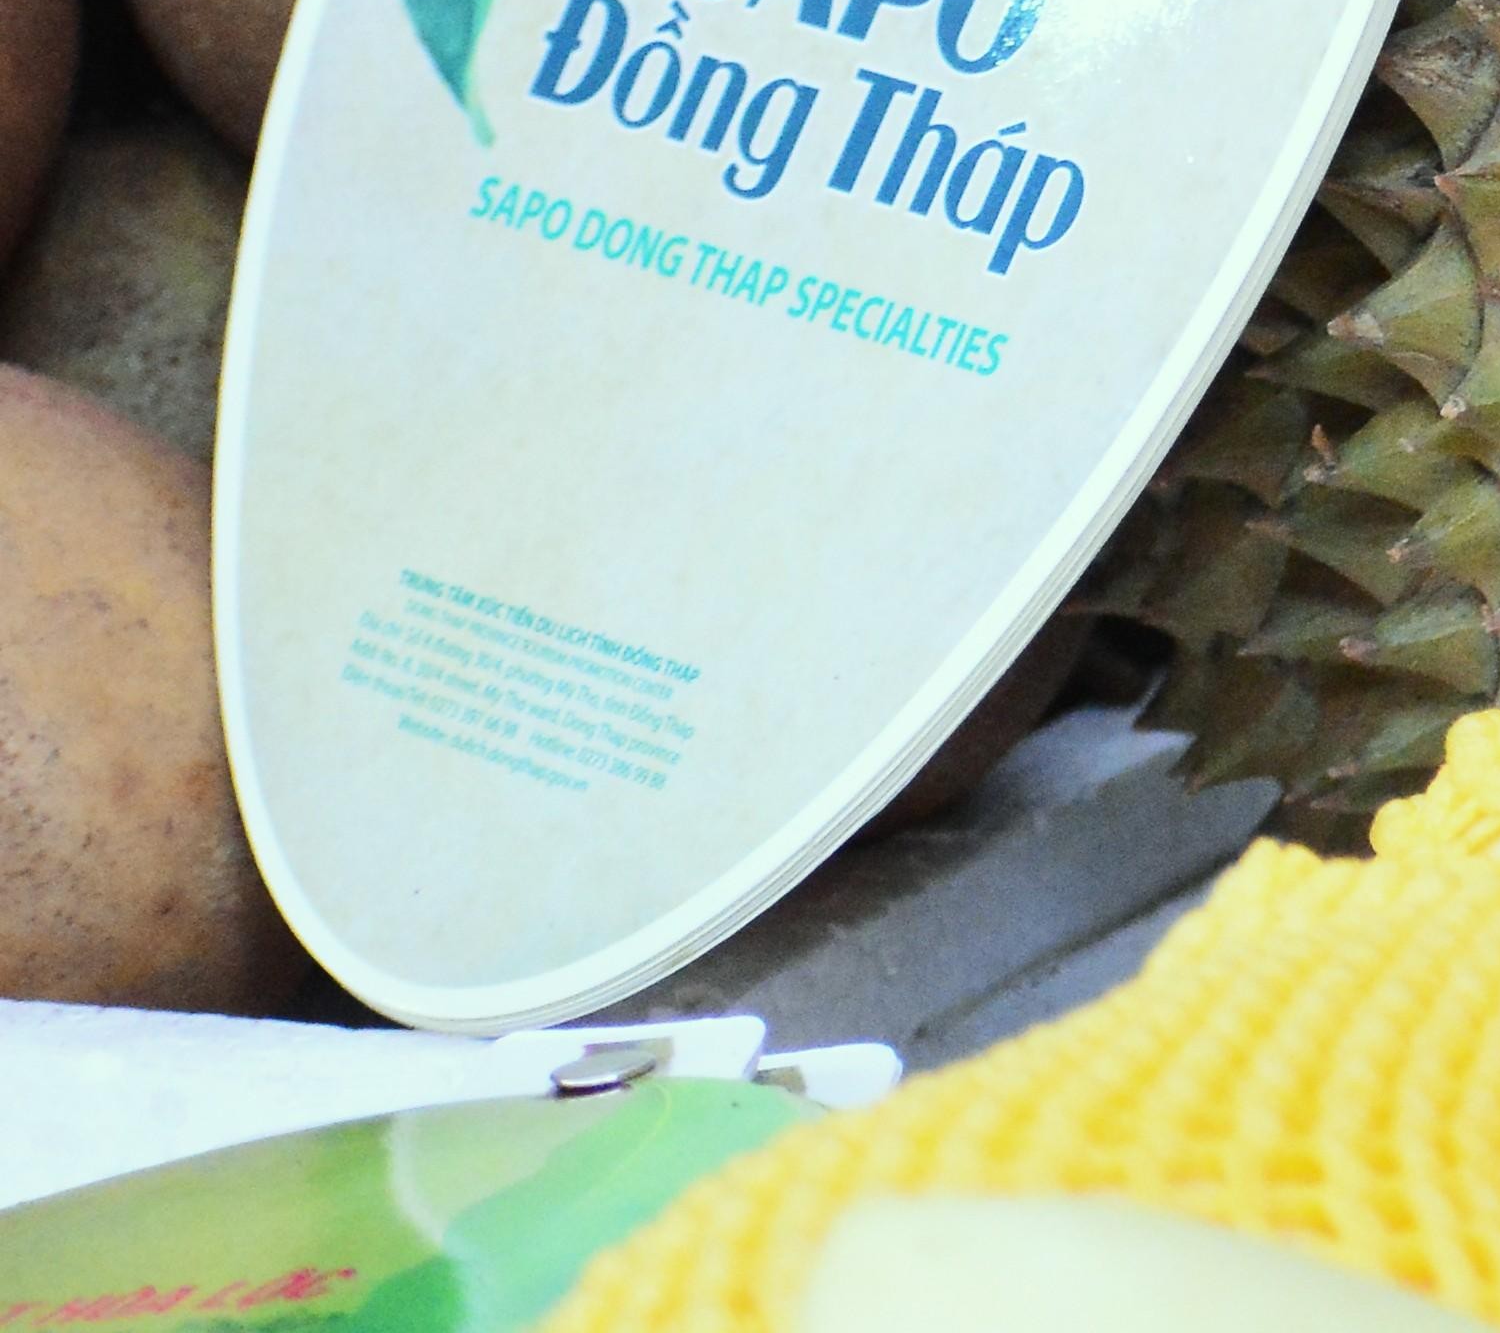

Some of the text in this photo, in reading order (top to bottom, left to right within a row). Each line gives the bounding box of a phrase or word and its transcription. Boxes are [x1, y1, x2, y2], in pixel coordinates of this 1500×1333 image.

[827, 67, 1086, 277] Tháp
[469, 176, 1009, 377] SAPO DONG THAP SPECIALTIES
